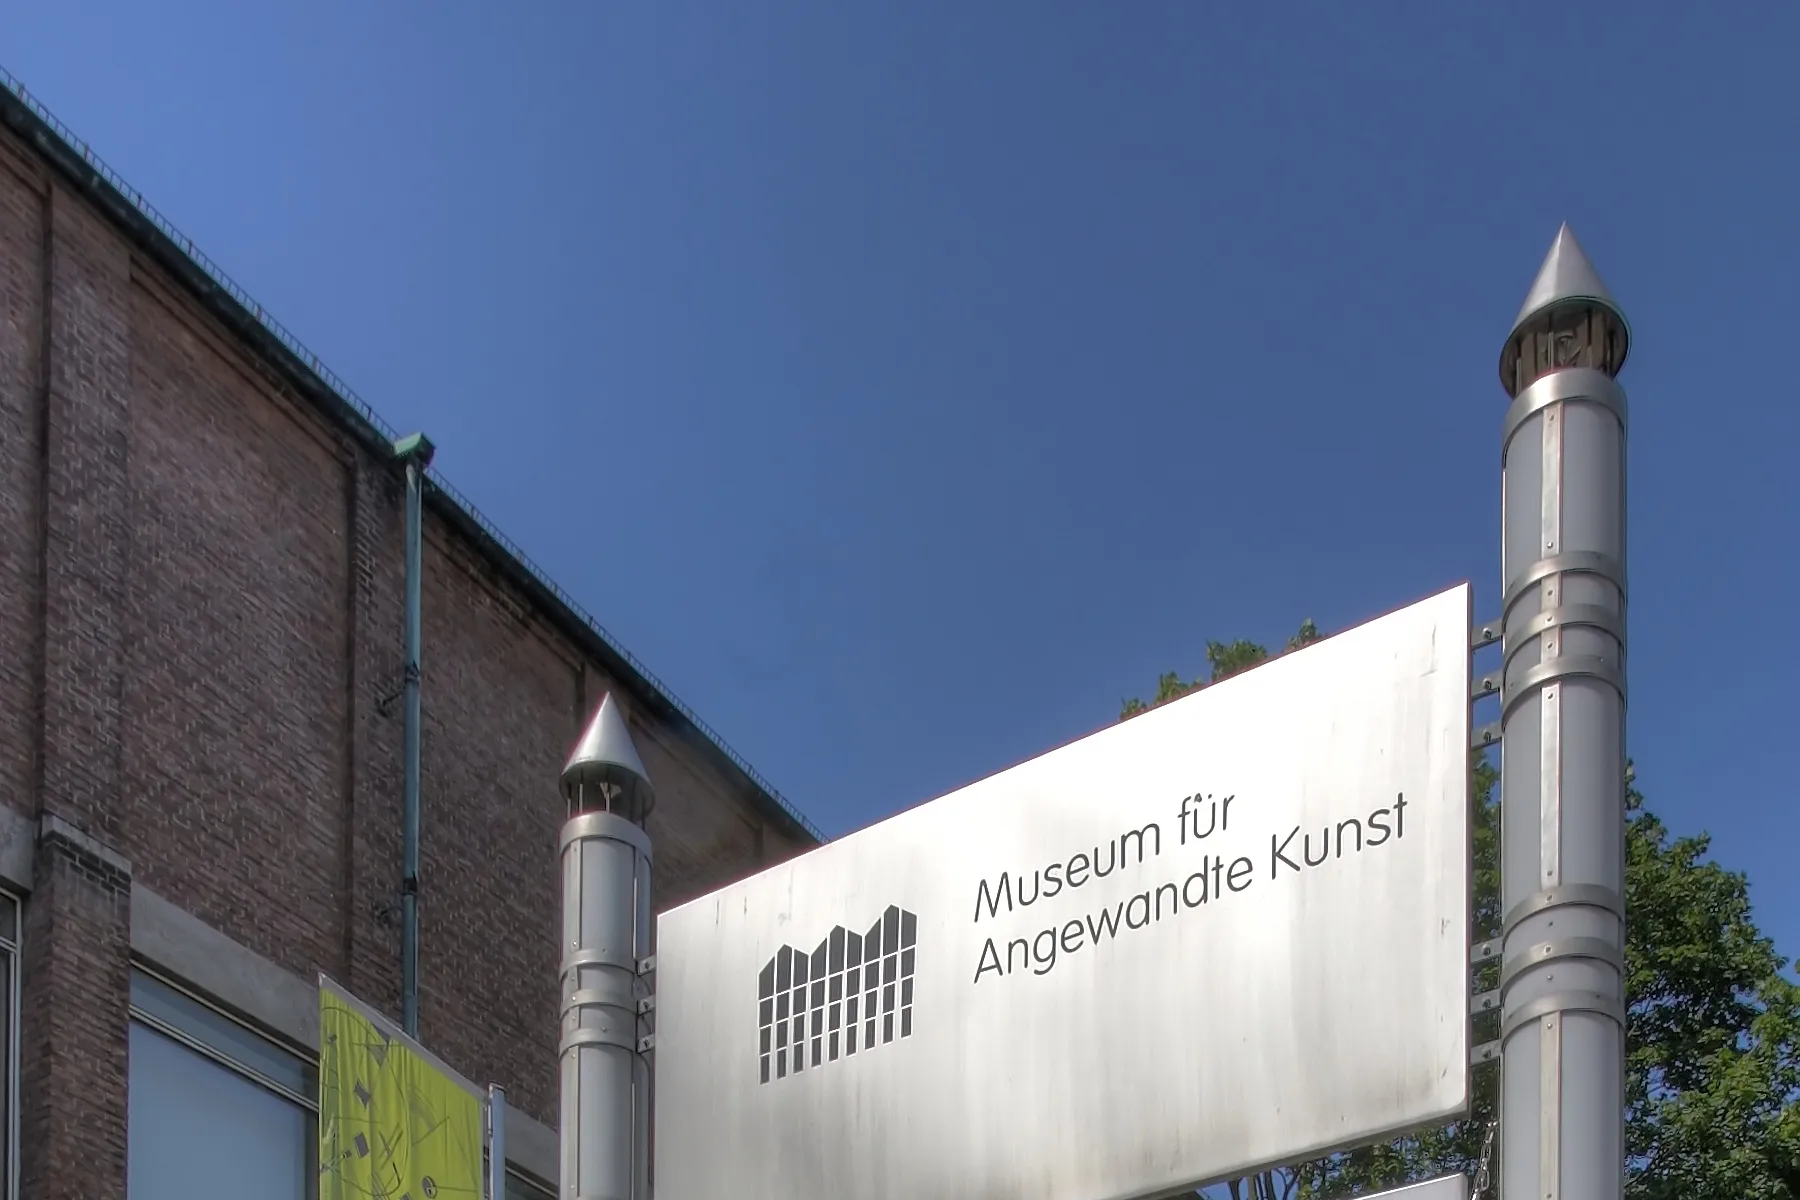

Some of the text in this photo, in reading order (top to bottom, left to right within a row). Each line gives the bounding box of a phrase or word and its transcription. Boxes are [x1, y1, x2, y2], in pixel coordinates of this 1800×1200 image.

[973, 791, 1408, 984] Angewandte Kunst
[974, 790, 1235, 924] Museum für
